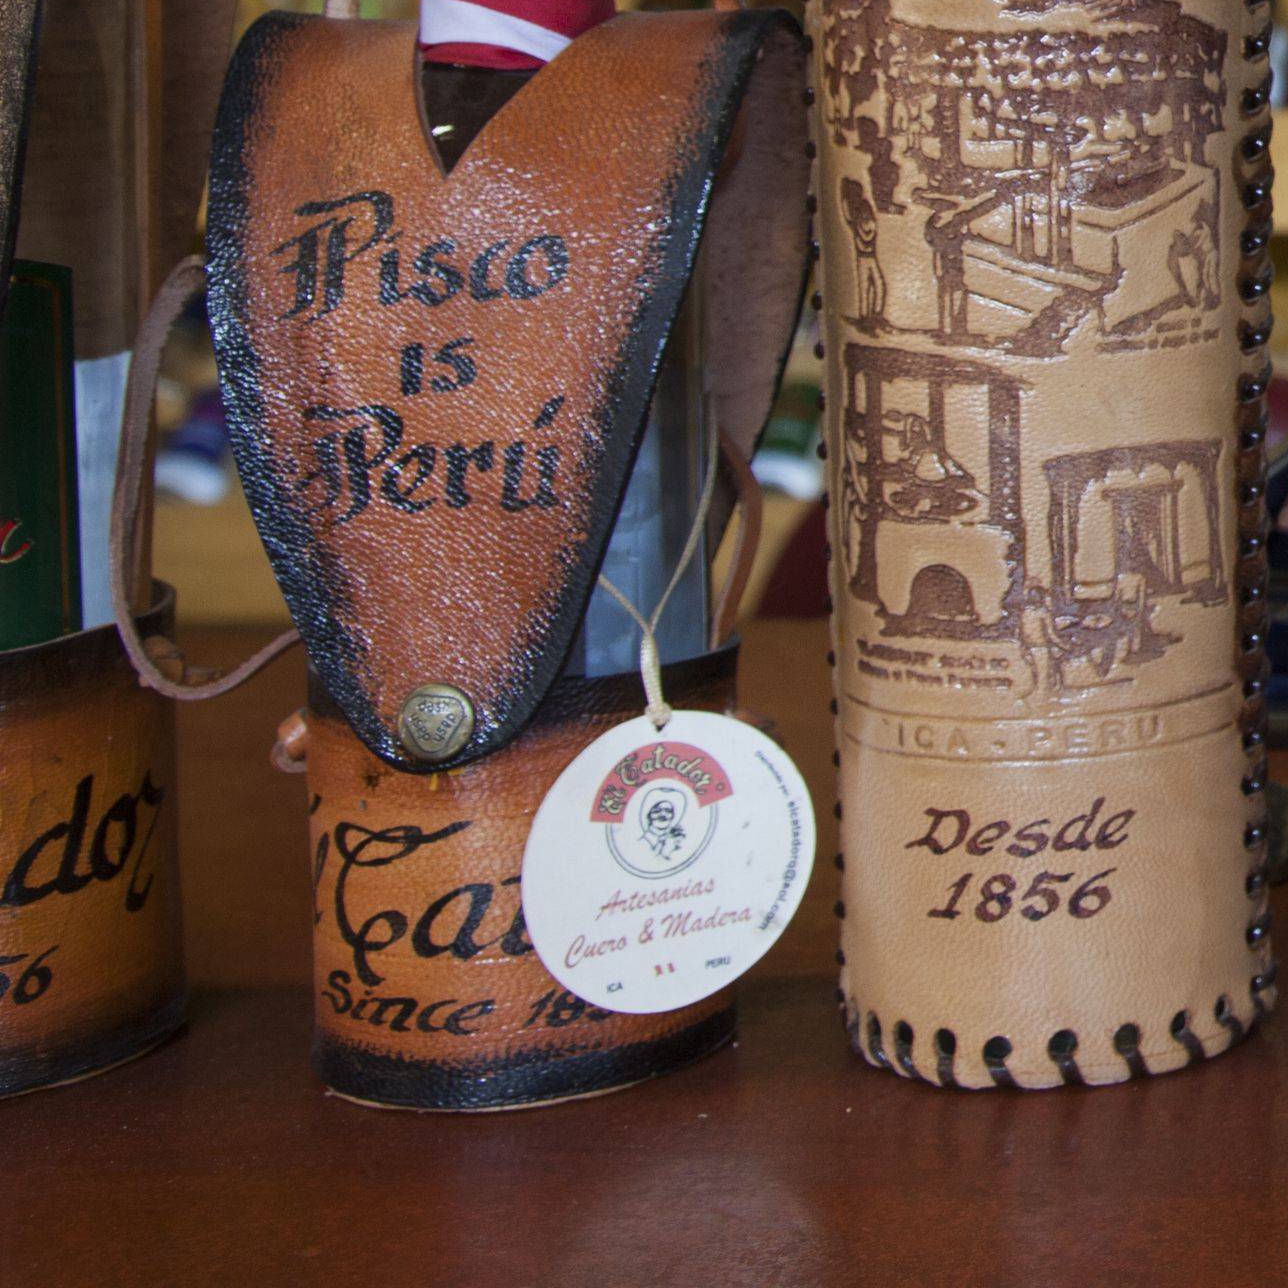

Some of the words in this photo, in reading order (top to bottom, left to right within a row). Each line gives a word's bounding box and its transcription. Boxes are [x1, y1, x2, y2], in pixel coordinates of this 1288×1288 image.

[268, 190, 570, 323] Pisco
[296, 396, 568, 525] Perú
[615, 742, 712, 796] Catador
[906, 797, 1137, 858] Desde
[927, 868, 1118, 923] 1856
[565, 934, 628, 970] Cuero
[638, 917, 656, 945] &
[661, 904, 752, 939] Madera
[322, 970, 496, 1036] Since
